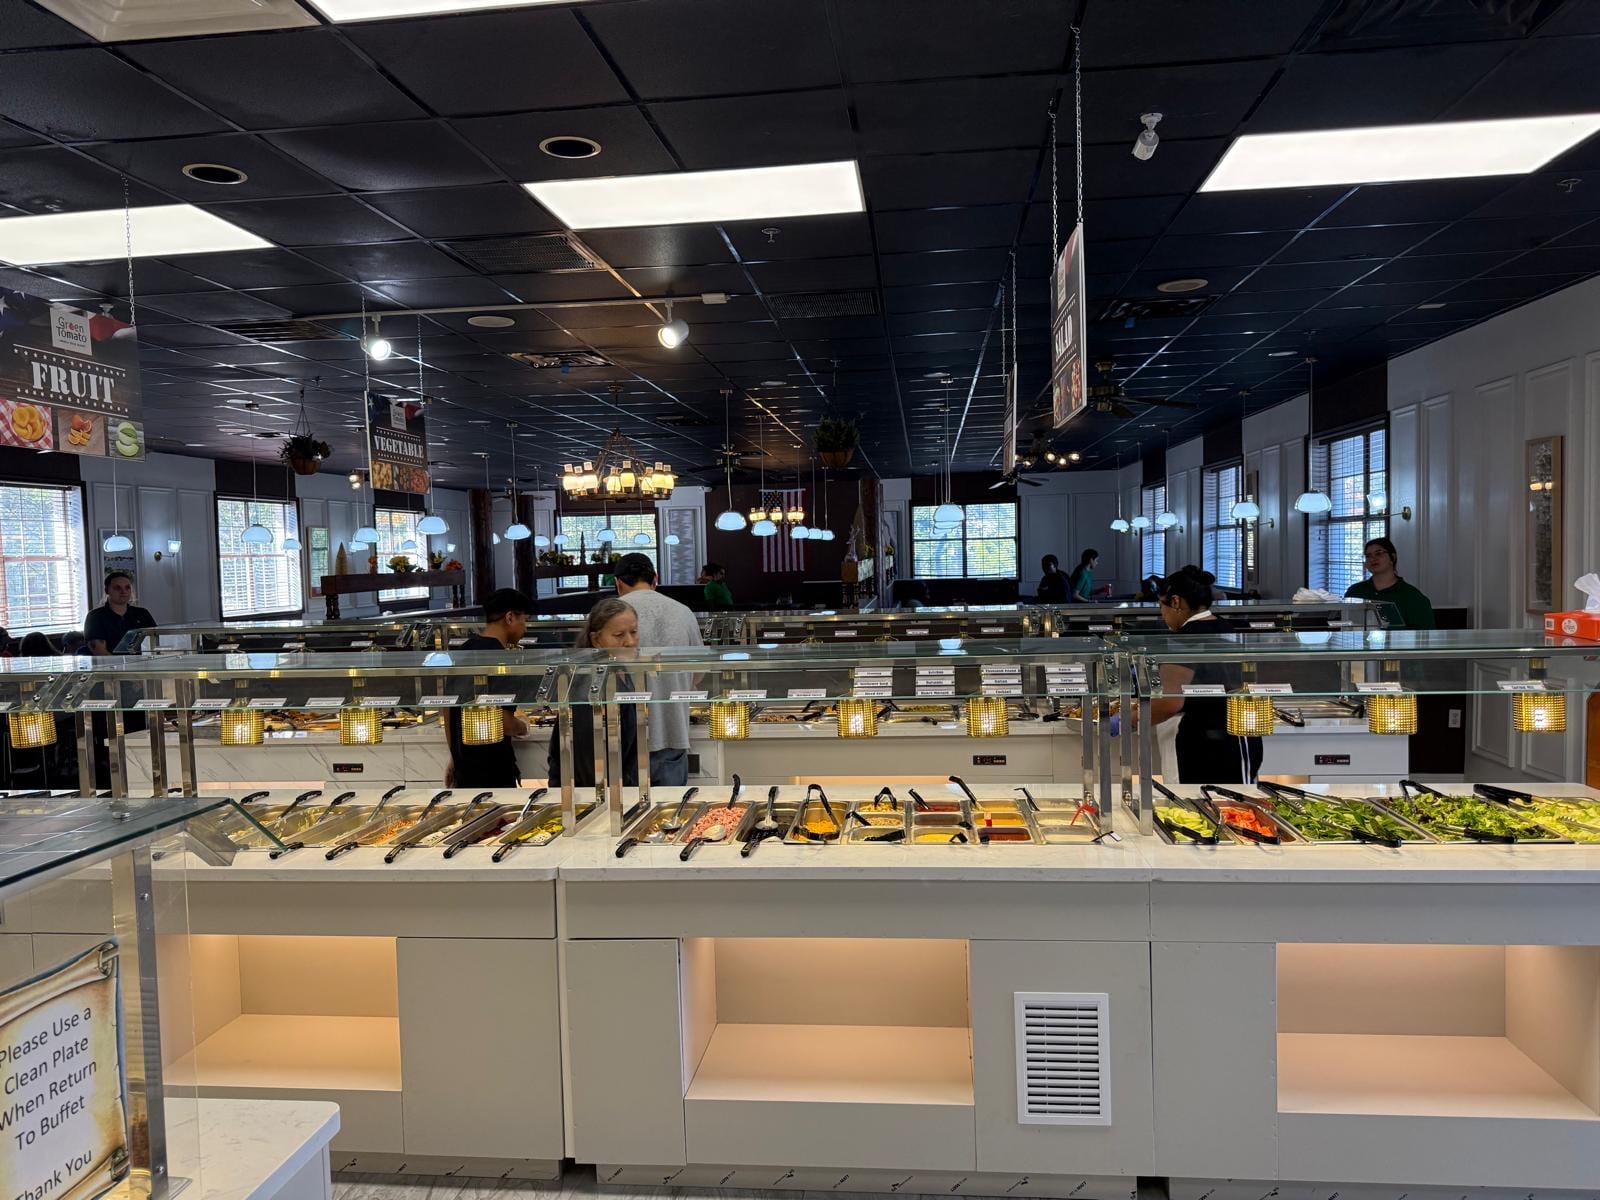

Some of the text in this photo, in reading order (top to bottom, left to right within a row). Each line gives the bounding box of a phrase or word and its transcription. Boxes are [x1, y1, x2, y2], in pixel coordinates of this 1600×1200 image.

[56, 325, 87, 343] Tomato
[31, 361, 115, 404] FRUIT
[374, 435, 424, 459] VEGETABLE
[52, 1015, 79, 1037] Use
[84, 1007, 92, 1019] a
[4, 1037, 89, 1095] Clean Plate
[0, 1061, 97, 1131] When Return
[14, 1095, 85, 1151] To Buffet
[65, 1149, 92, 1177] You
